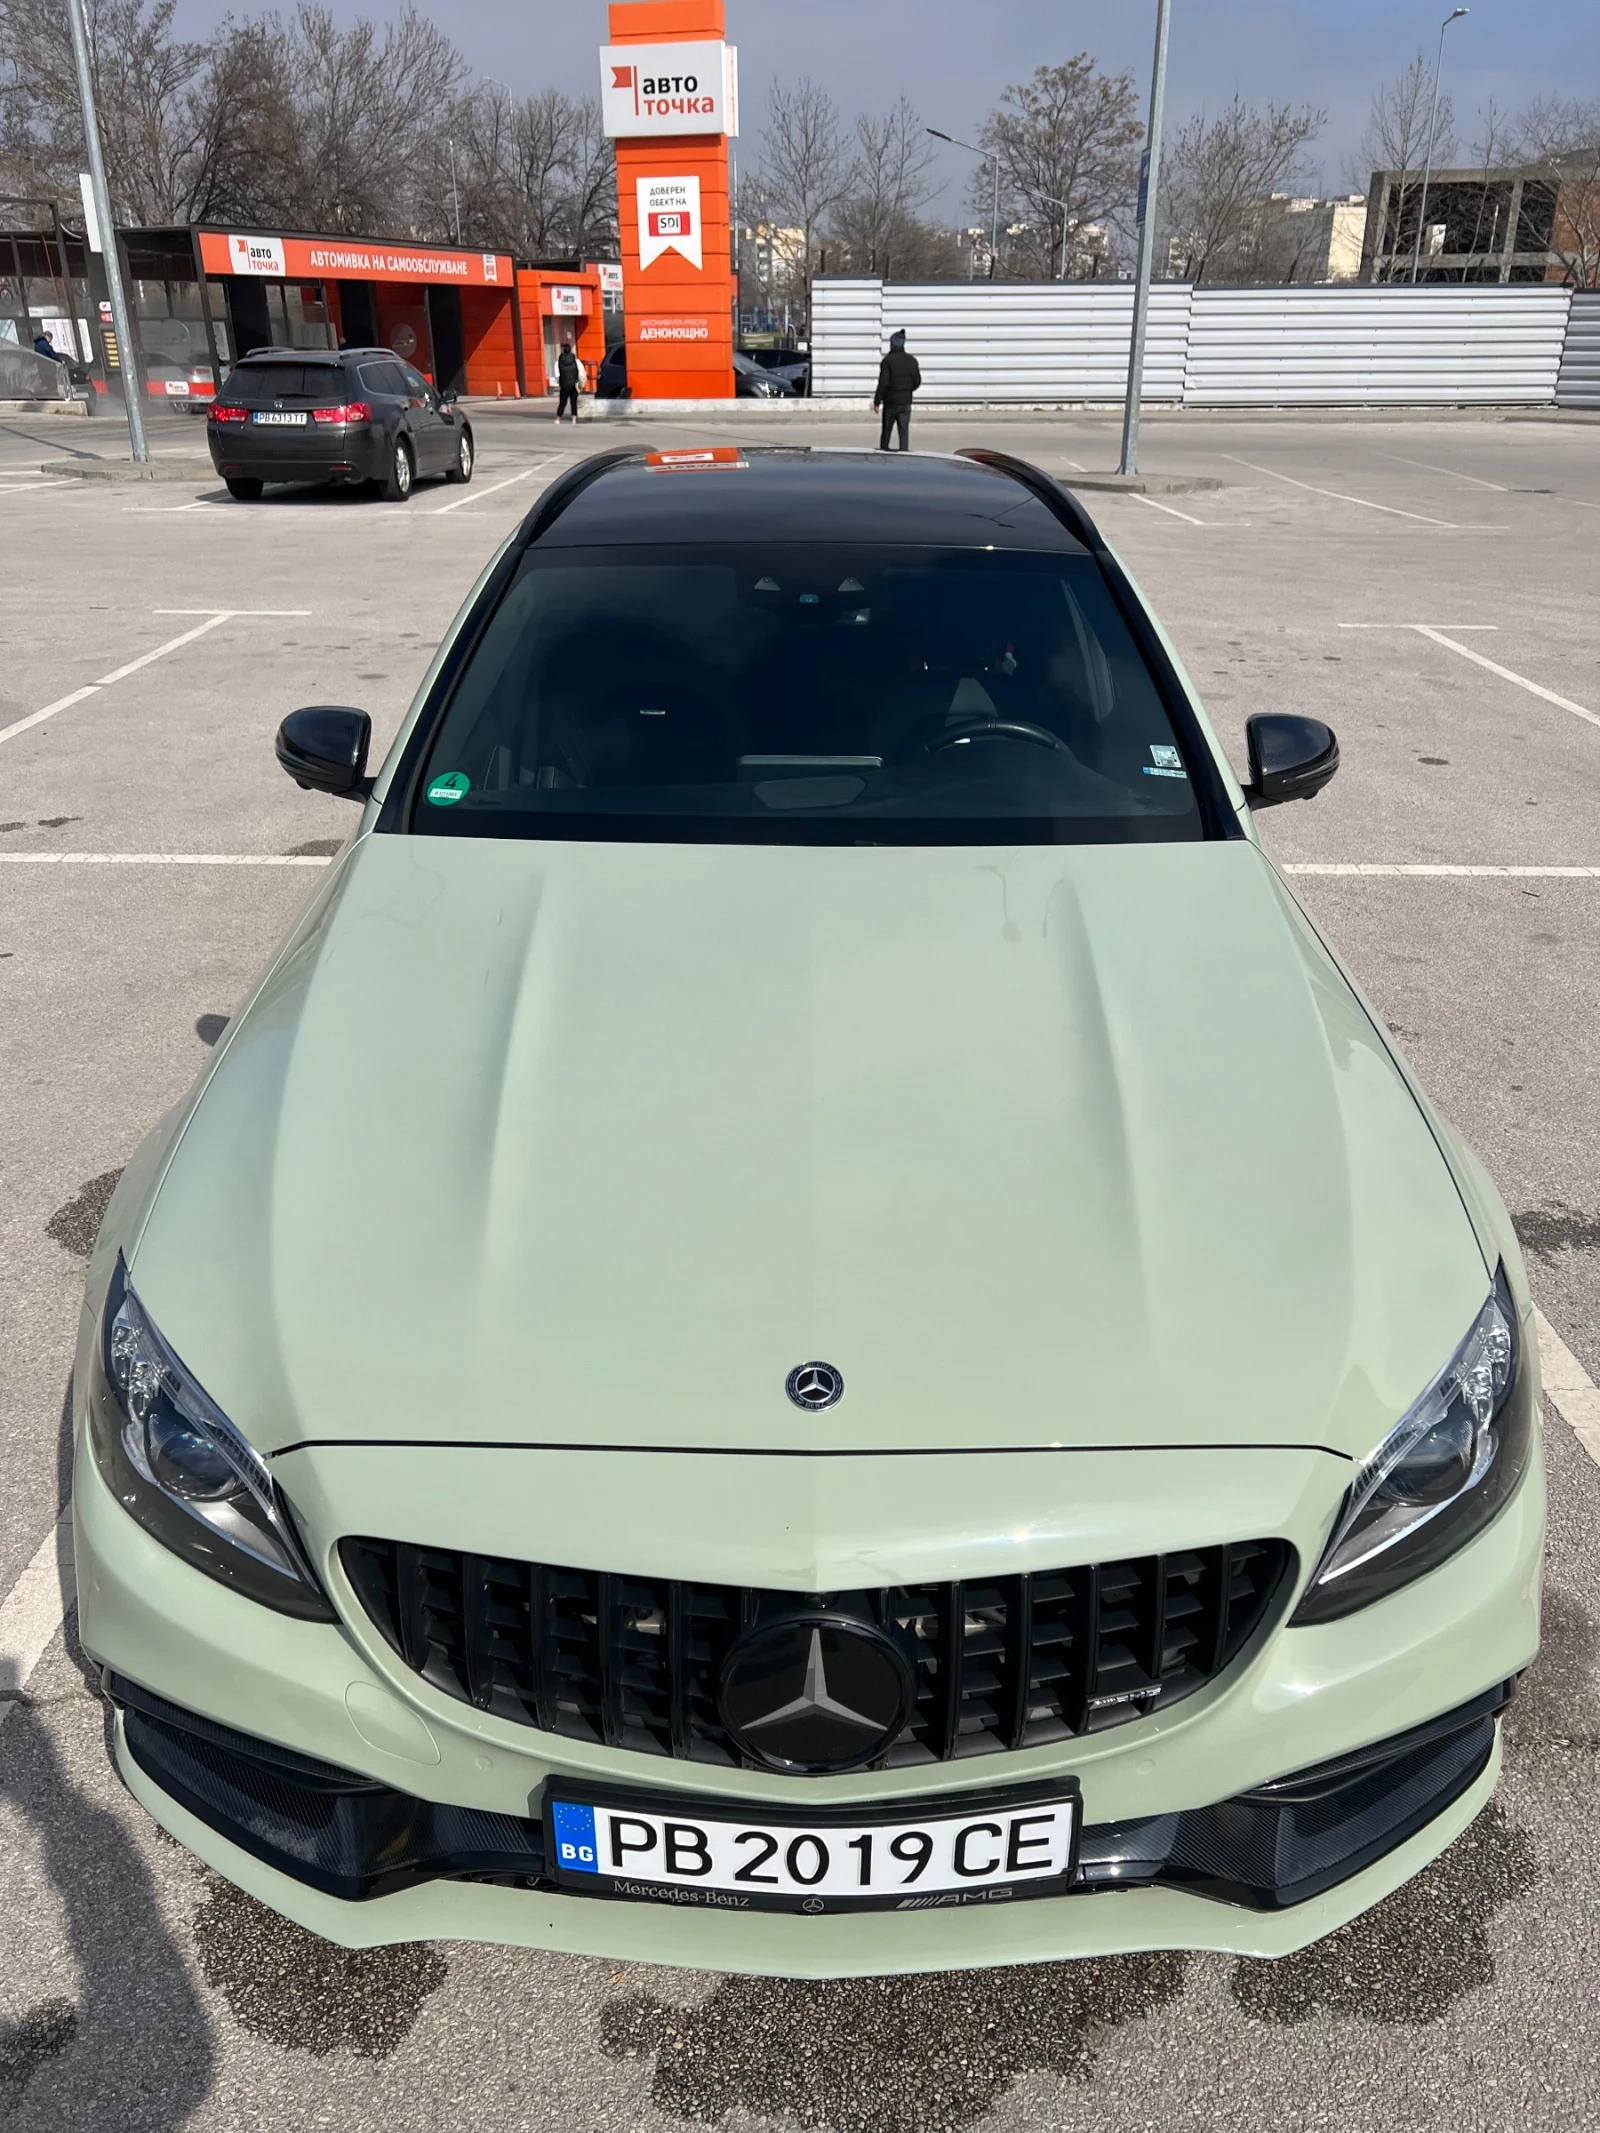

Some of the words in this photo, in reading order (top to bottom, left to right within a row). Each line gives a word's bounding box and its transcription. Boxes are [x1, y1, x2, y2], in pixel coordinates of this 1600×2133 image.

[642, 74, 698, 95] авто
[644, 96, 715, 116] точка
[649, 186, 686, 196] ДОВЕРЕН
[649, 197, 675, 207] ОБЕКТ
[675, 197, 688, 206] НА
[659, 216, 680, 229] SDI
[250, 247, 272, 259] авто
[251, 260, 279, 271] точка
[310, 250, 371, 270] АВТОМИВКА
[371, 255, 386, 270] НА
[387, 256, 468, 275] САМООБСЛУЖВАНЕ
[640, 327, 709, 340] ДЕНОНОЩНО
[444, 773, 458, 789] 4
[561, 1843, 594, 1862] BG
[608, 1815, 713, 1877] PB
[733, 1830, 934, 1887] 2019
[952, 1813, 1056, 1878] CE
[613, 1880, 750, 1907] Mercedes-Benz
[935, 1887, 1014, 1906] AMG
